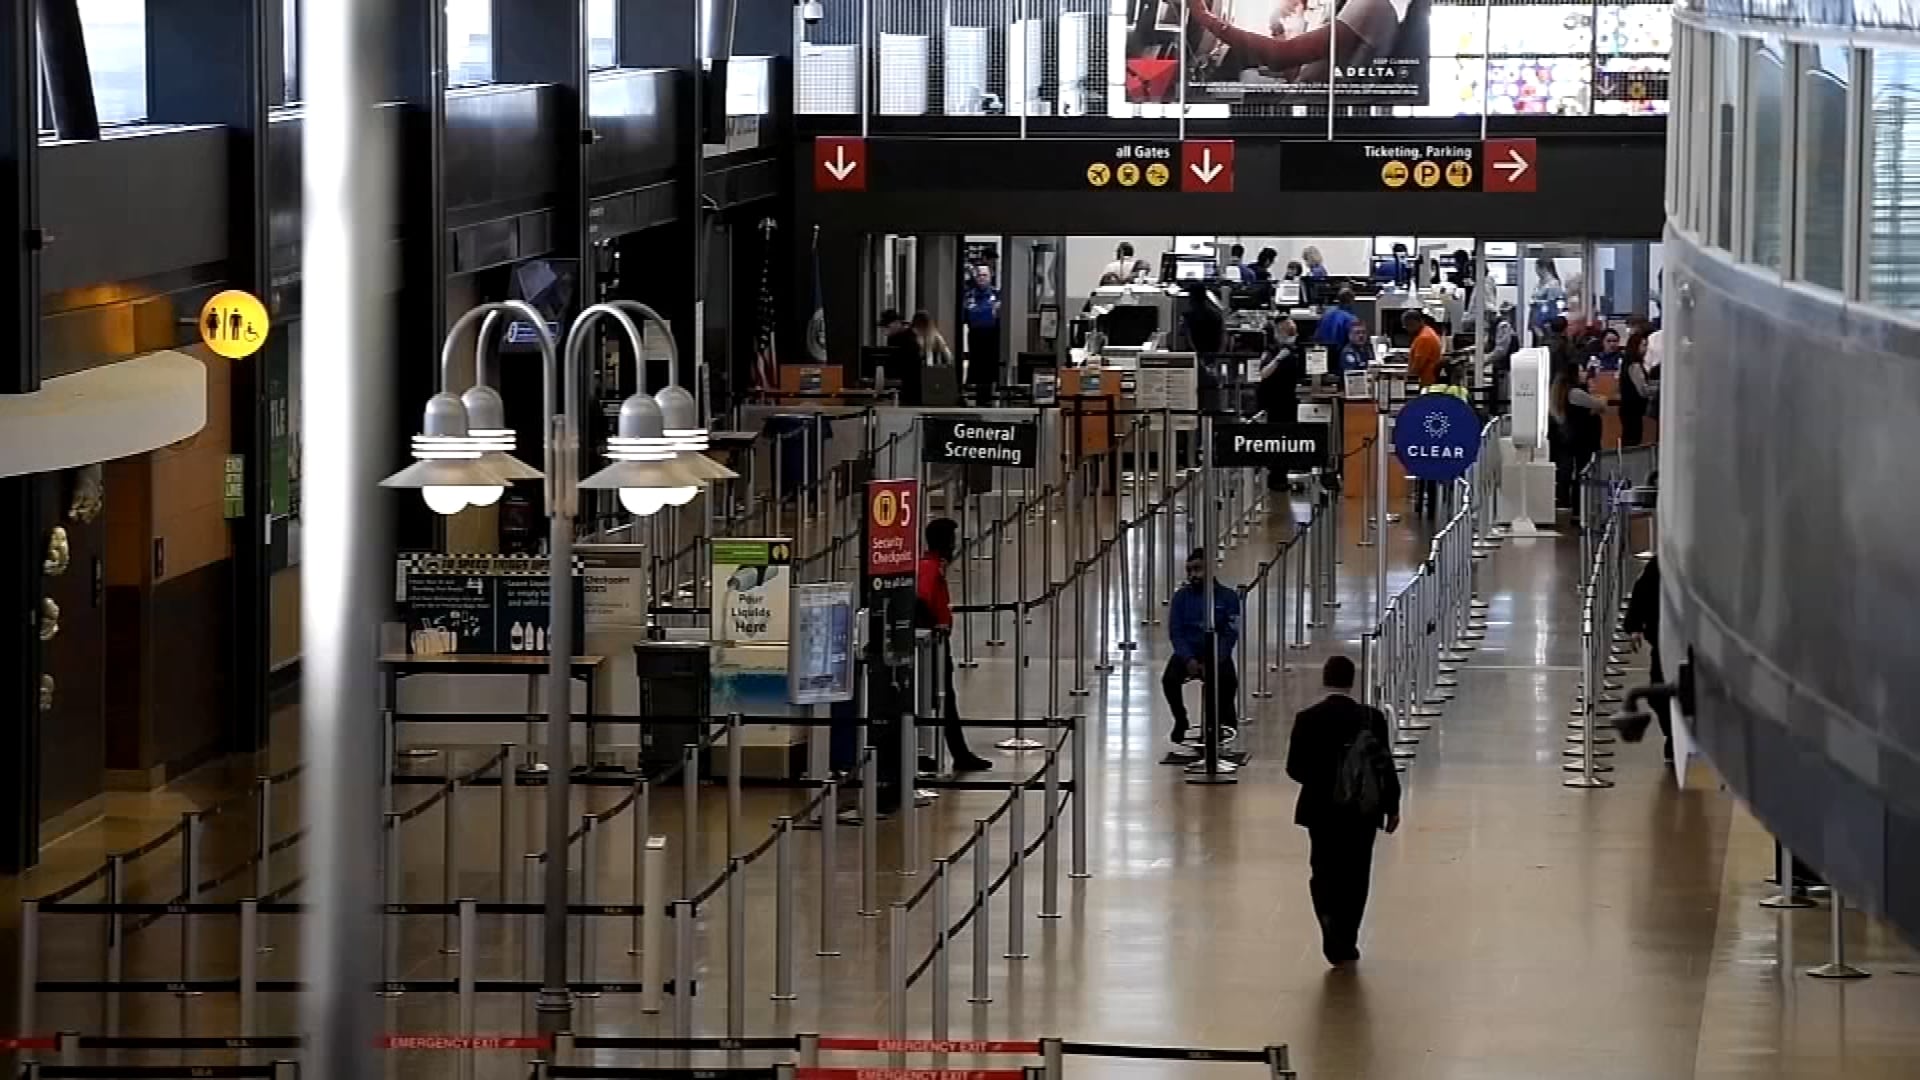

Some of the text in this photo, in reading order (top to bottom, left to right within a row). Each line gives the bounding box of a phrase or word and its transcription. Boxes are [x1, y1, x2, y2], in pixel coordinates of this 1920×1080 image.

[1346, 67, 1395, 77] DELTA
[1116, 145, 1170, 159] all Gates
[1364, 145, 1473, 161] Ticketing, Parking
[953, 423, 1015, 441] General
[1234, 435, 1316, 453] Premium
[944, 441, 1021, 465] Screening
[1407, 445, 1464, 459] CLEAR
[900, 491, 911, 527] 5
[872, 537, 904, 551] Security
[872, 550, 913, 567] Checkpoint
[738, 593, 763, 605] Pour
[731, 607, 771, 619] Liquids
[735, 622, 767, 633] Here
[390, 1037, 500, 1049] EMERGENCY EXIT
[877, 1039, 988, 1052] EMERGENCY EXIT
[856, 1070, 968, 1080] EMERGENCY EXIT
